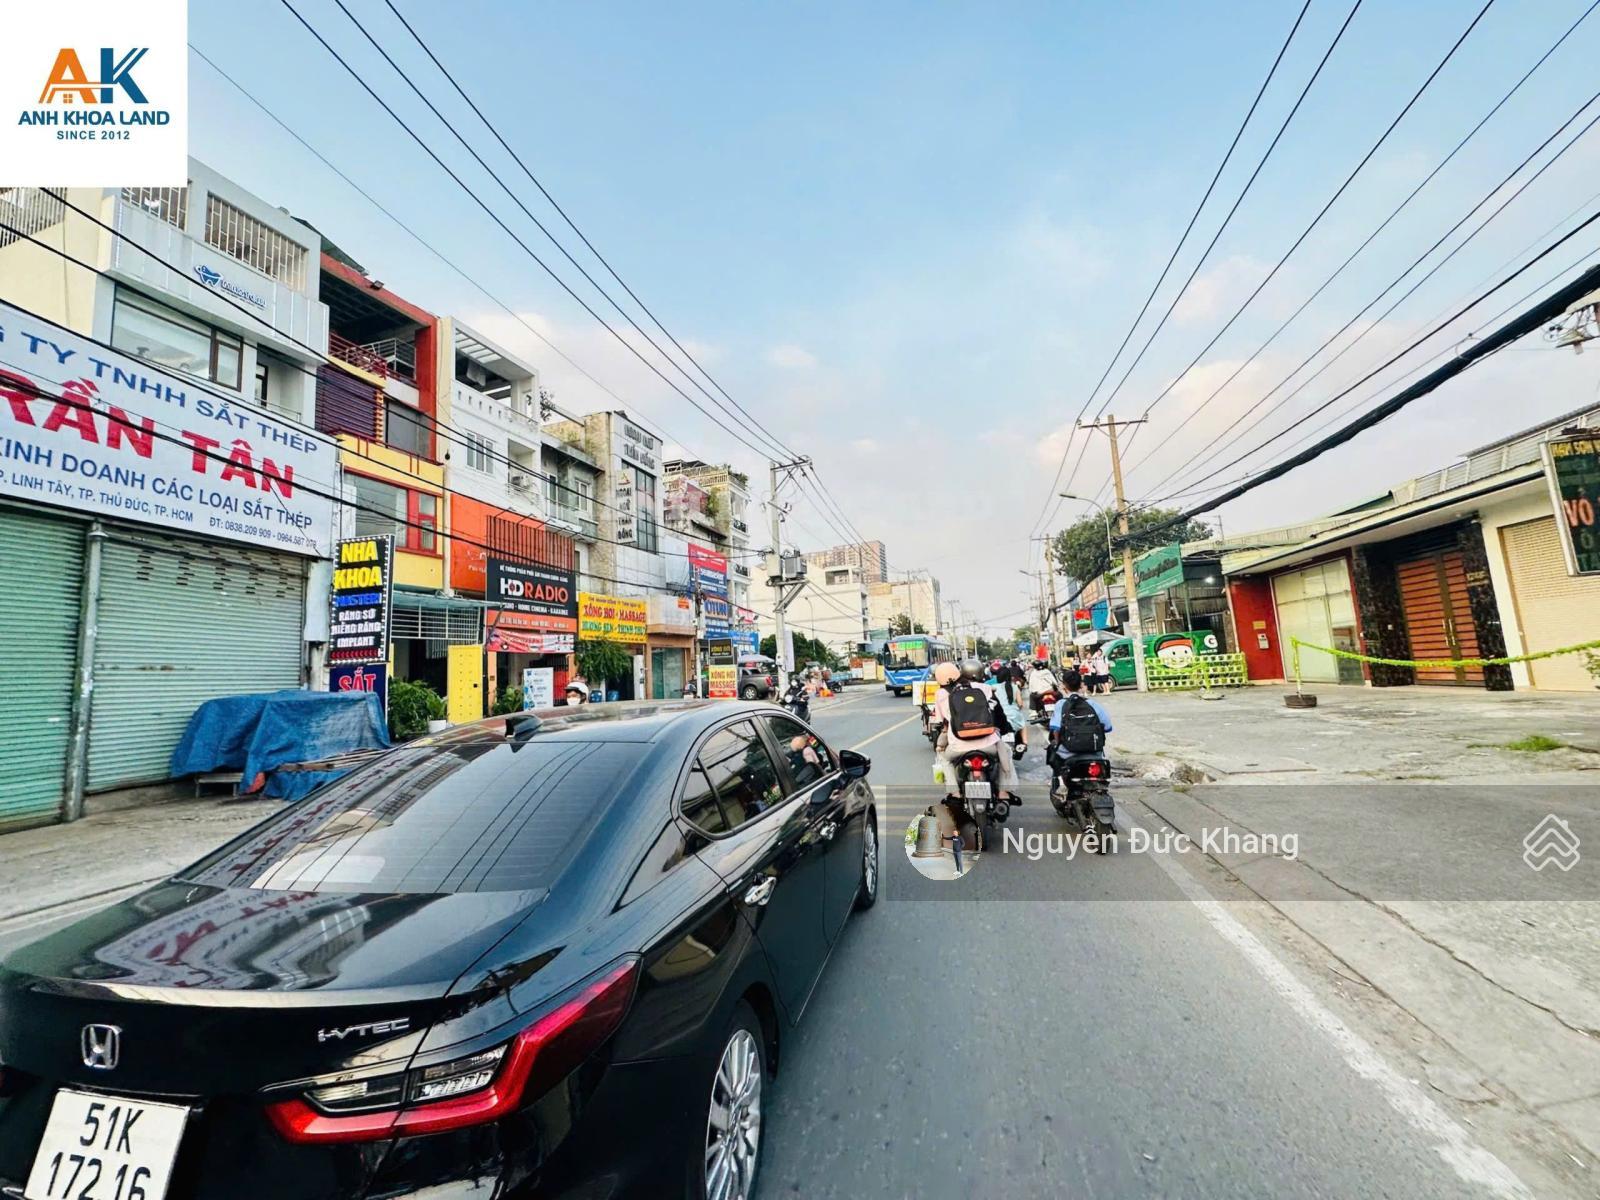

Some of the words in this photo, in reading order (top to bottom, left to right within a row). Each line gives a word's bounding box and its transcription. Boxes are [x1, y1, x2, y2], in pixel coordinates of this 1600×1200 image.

[21, 331, 76, 364] TY
[88, 357, 186, 408] TNHH
[196, 399, 249, 430] SẮT
[257, 422, 318, 454] THÉP
[182, 430, 293, 499] TÂN
[12, 473, 43, 490] LINH
[78, 488, 96, 502] TP.
[155, 504, 168, 517] TP.
[172, 508, 193, 522] HCM
[62, 453, 145, 489] DOANH
[152, 477, 193, 501] CÁC
[200, 489, 238, 514] LOẠI
[276, 509, 312, 529] THÉP
[341, 541, 378, 563] NHA
[334, 566, 382, 589] KHOA
[337, 636, 376, 648] IMPLANT
[710, 680, 736, 689] MASSAGE
[80, 1103, 144, 1153] 51K
